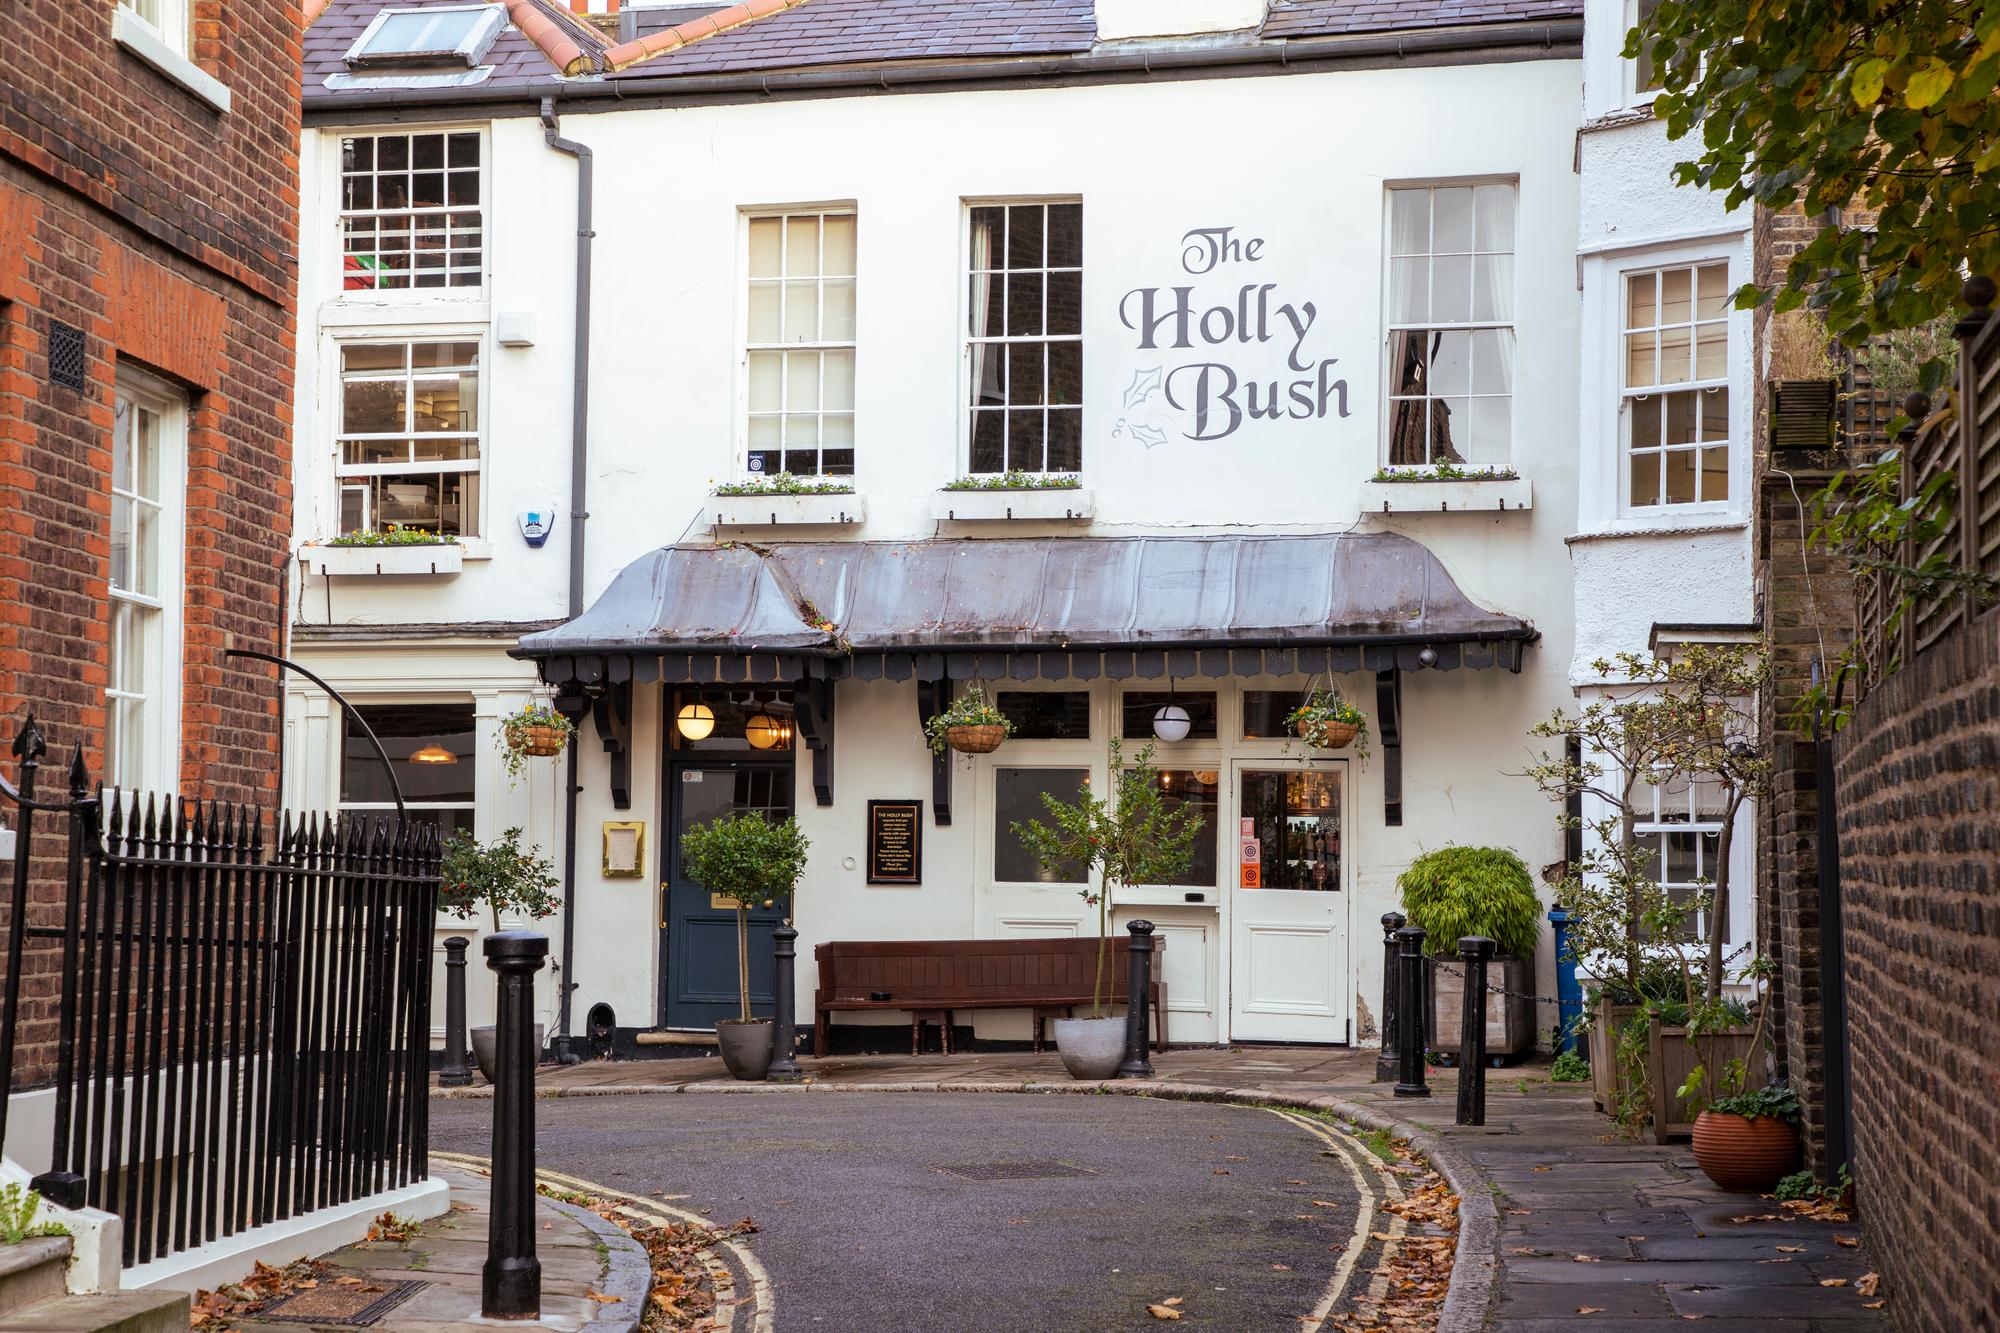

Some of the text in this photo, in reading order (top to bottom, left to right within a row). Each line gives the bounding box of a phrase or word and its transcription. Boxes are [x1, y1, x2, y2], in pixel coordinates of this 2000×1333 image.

[1181, 226, 1265, 275] The
[1119, 284, 1317, 372] Holly
[1164, 358, 1352, 442] Bush
